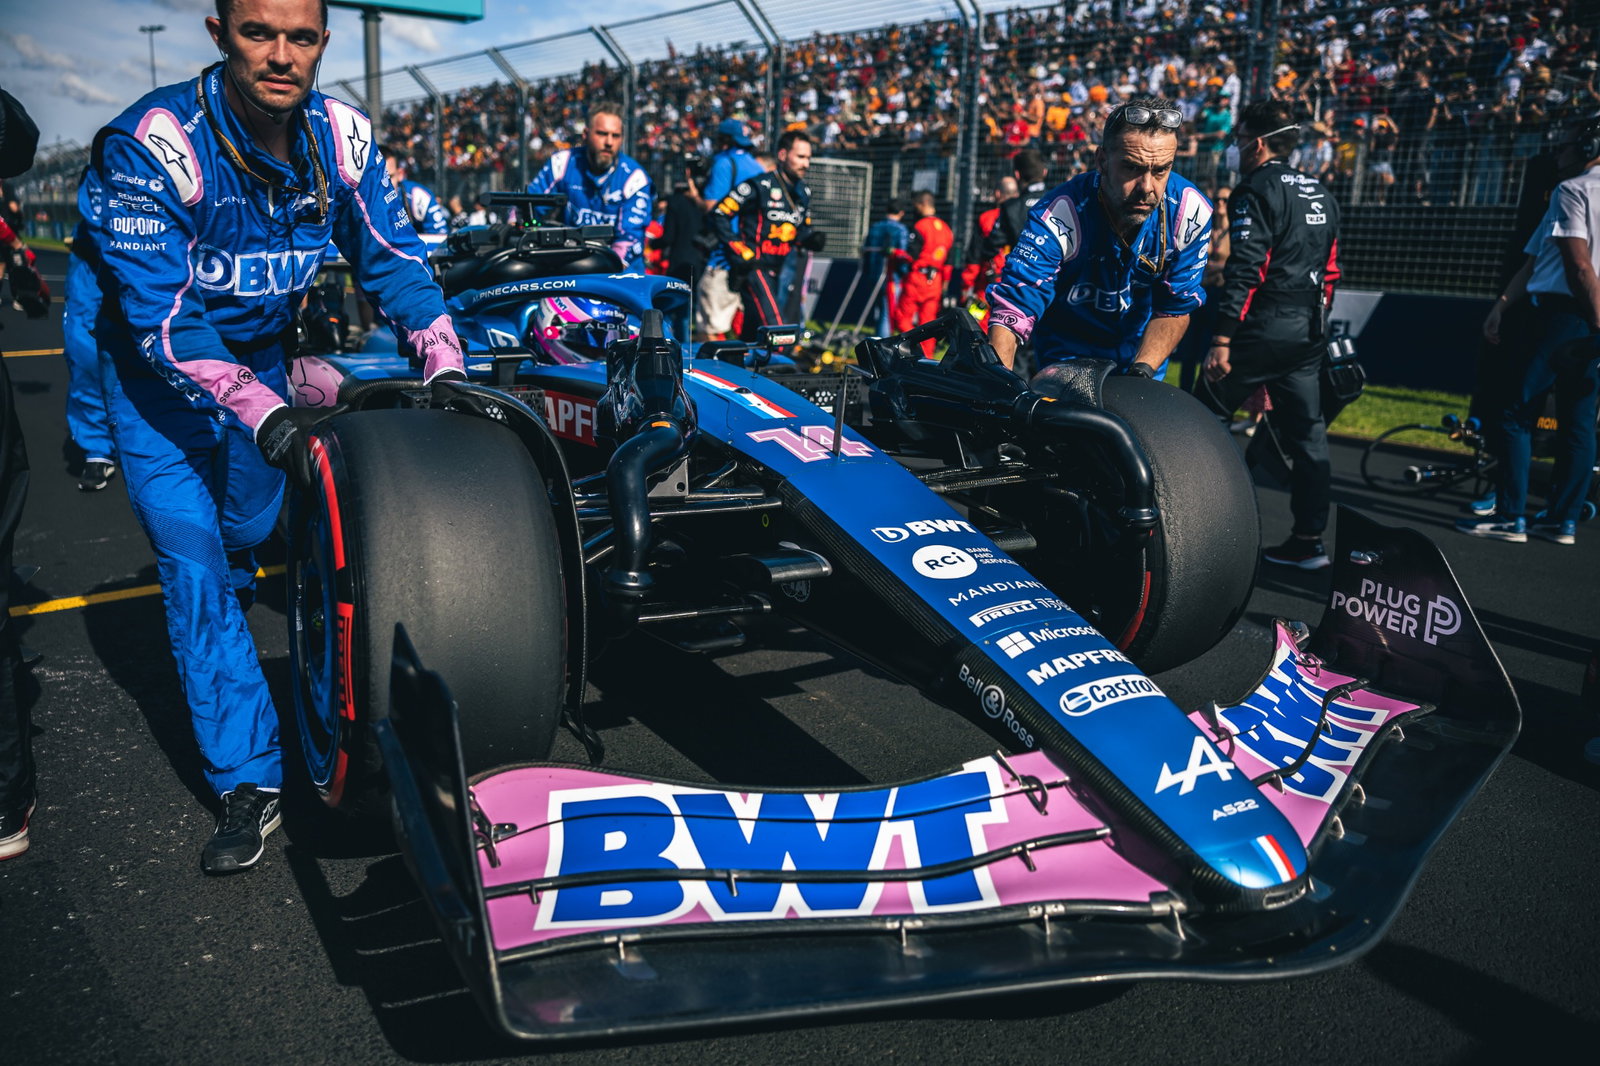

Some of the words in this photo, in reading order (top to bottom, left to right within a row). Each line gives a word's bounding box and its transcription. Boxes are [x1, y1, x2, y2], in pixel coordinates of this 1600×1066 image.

[113, 217, 161, 236] DUPONT
[472, 279, 577, 303] ALPINECARS.COM
[584, 322, 629, 332] ALPIN
[544, 397, 597, 437] APF
[744, 426, 874, 462] 14
[905, 519, 977, 536] BWT
[1360, 578, 1420, 615] PLUG
[968, 600, 1038, 628] PIRELLI
[1331, 590, 1418, 638] POWER
[1088, 676, 1160, 703] Castrol
[958, 664, 984, 696] Bell
[1003, 708, 1036, 749] Ross
[1212, 798, 1259, 821] A522
[534, 755, 1008, 930] BWT
